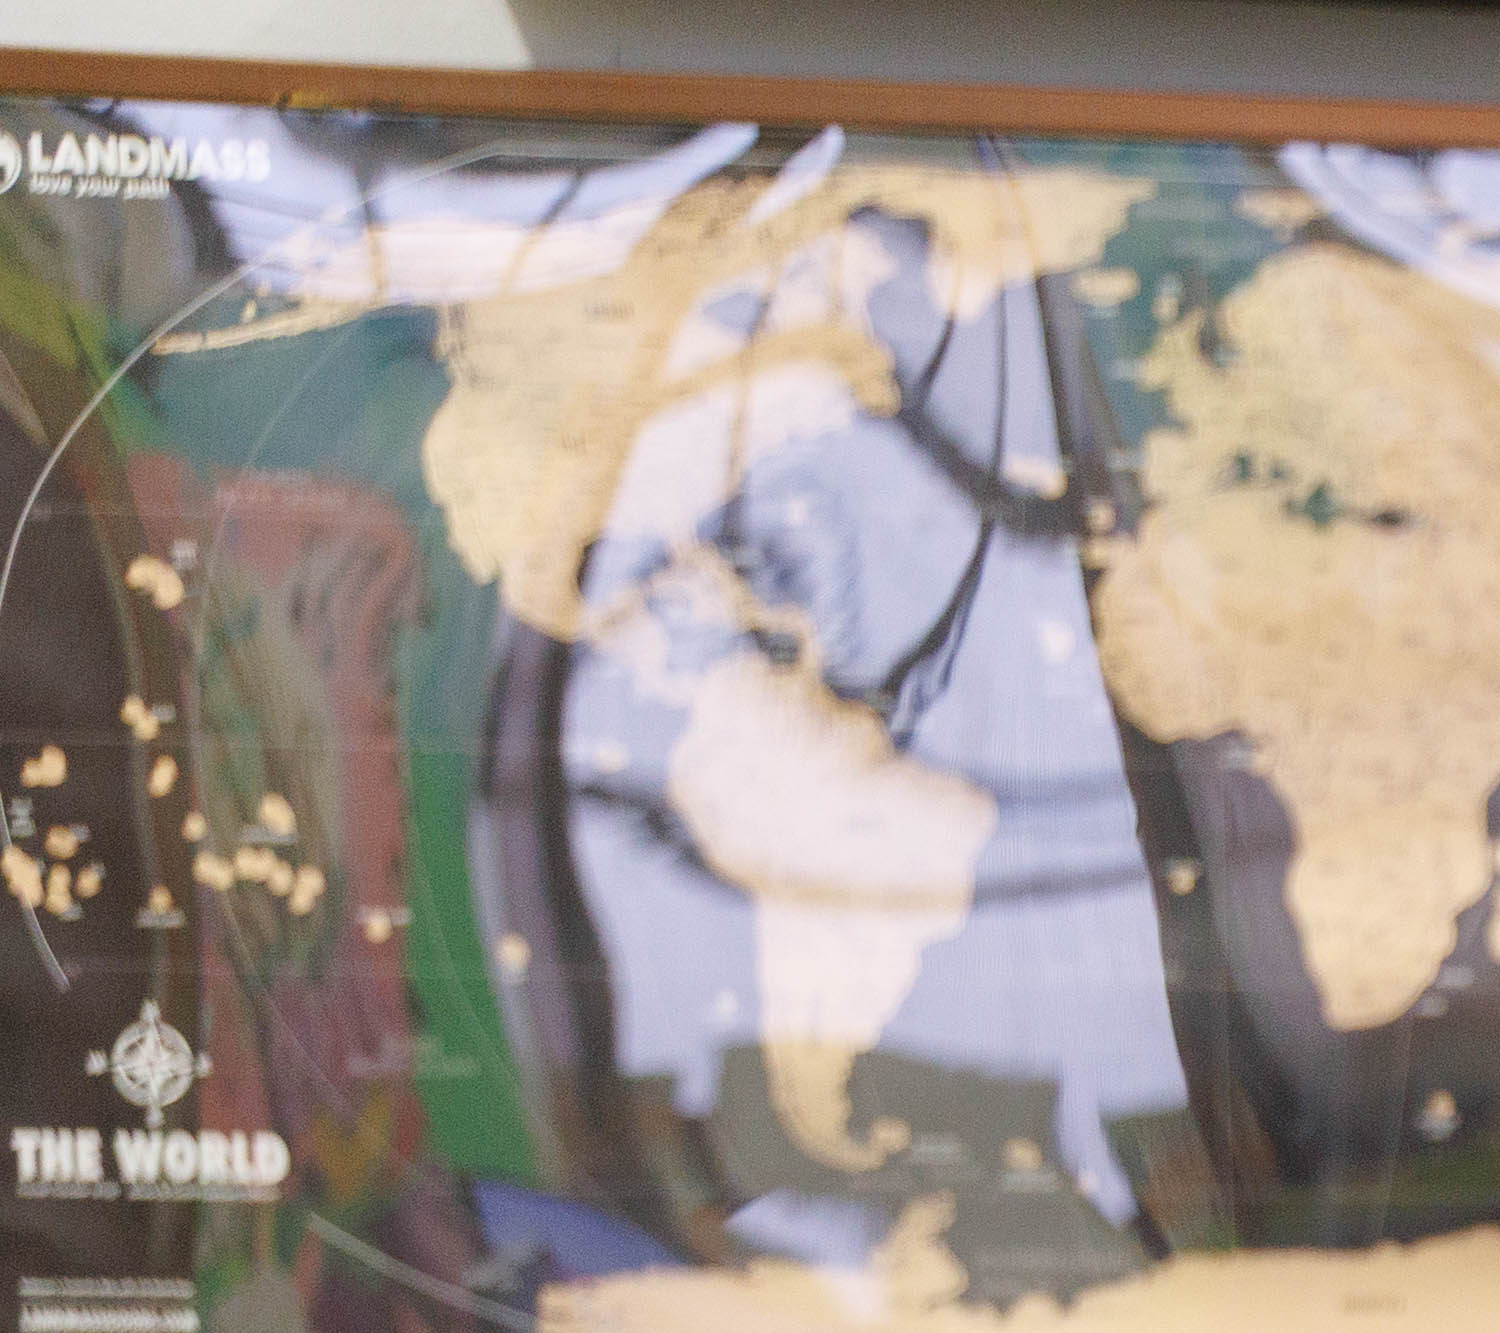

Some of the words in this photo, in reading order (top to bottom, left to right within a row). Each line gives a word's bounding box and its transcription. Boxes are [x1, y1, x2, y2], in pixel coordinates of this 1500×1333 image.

[27, 129, 269, 183] LANDMASS
[11, 1127, 104, 1185] THE
[113, 1129, 291, 1186] WORLD
